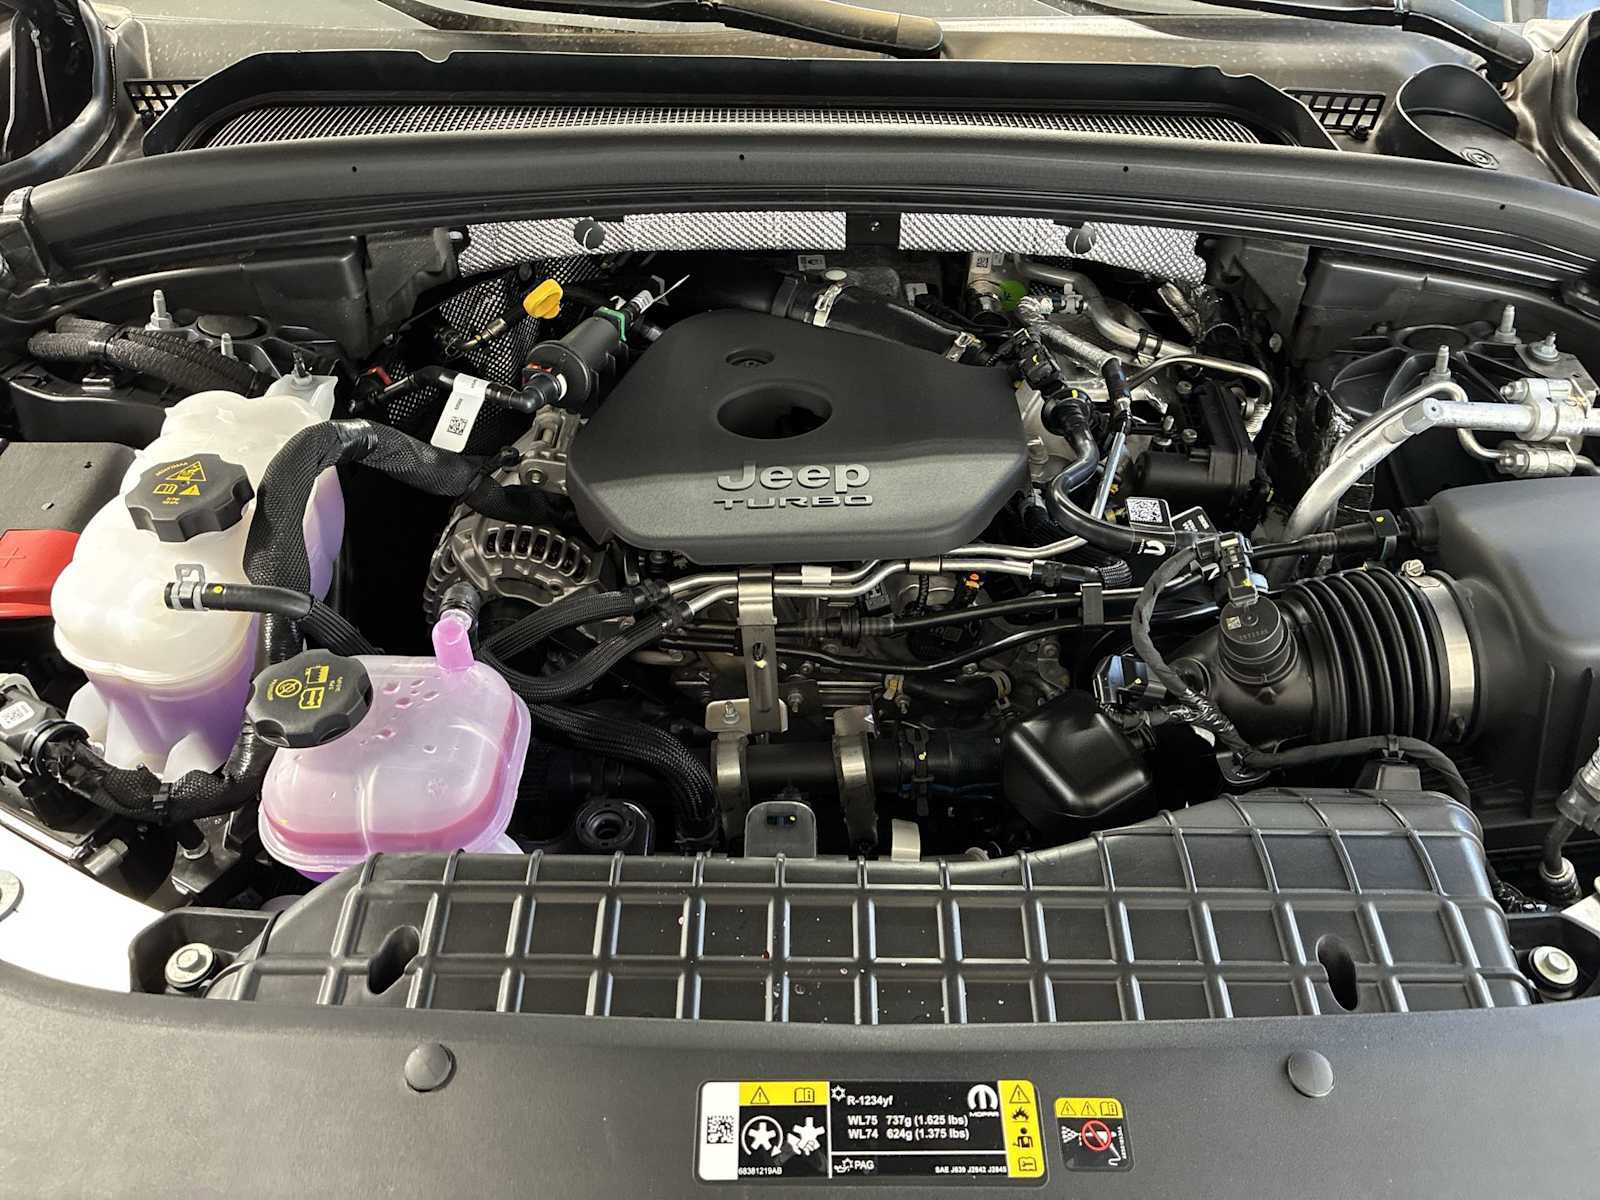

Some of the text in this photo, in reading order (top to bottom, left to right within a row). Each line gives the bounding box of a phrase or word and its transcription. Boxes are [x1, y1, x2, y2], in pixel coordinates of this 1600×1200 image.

[717, 460, 870, 494] Jeep
[713, 495, 873, 511] TURBO
[846, 1095, 894, 1108] R-1234yf
[847, 1115, 968, 1128] WL75 737g (1.625 lbs)
[847, 1129, 970, 1141] WL74 624g (1.375 lbs)
[854, 1159, 875, 1170] PAG
[934, 1165, 950, 1174] SAE
